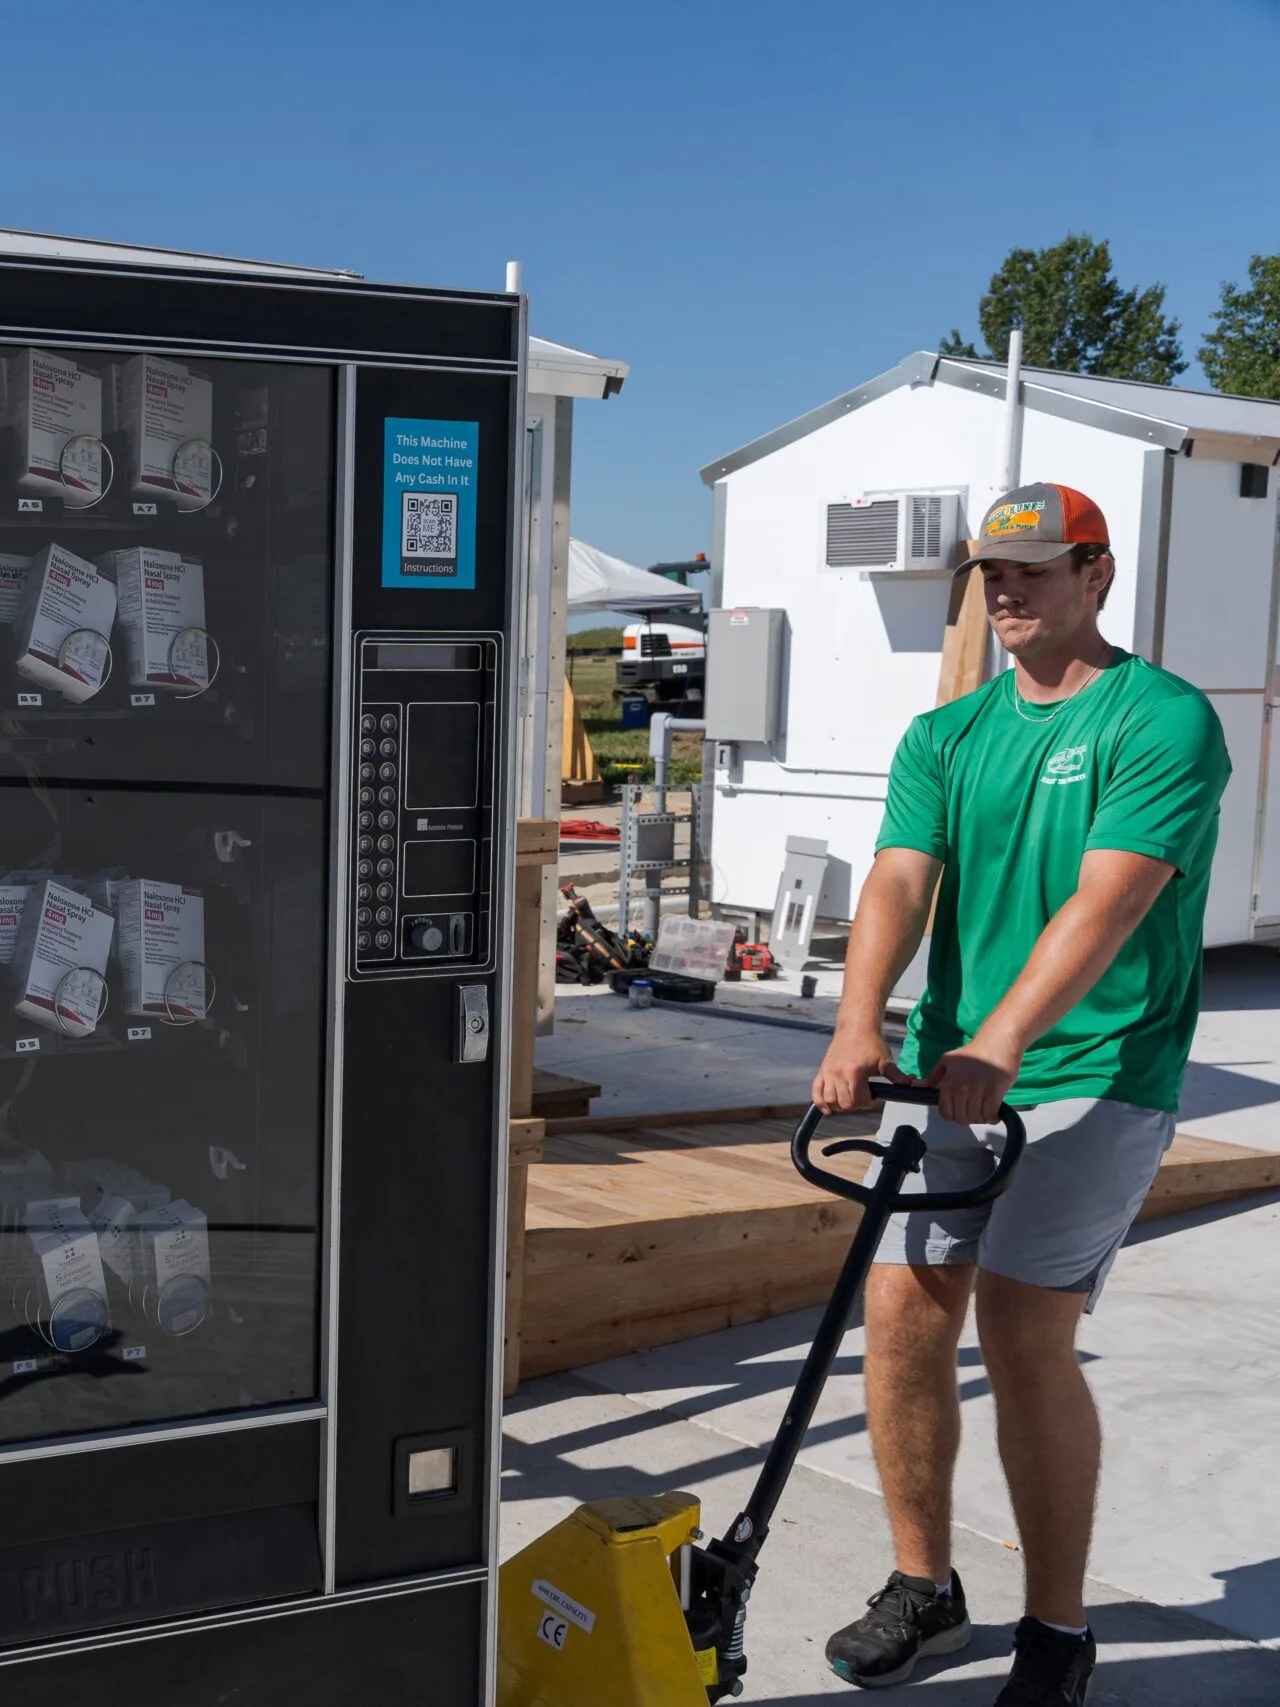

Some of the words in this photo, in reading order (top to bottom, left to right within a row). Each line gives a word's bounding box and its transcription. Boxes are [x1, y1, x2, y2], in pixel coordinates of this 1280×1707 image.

[33, 360, 66, 377] Naloxone
[33, 368, 53, 380] Nasal
[54, 375, 74, 388] Spray
[396, 435, 417, 446] This
[421, 436, 467, 448] Machine
[393, 454, 419, 465] Does
[422, 456, 442, 466] Not
[445, 457, 472, 468] Have
[396, 472, 416, 486] Any
[419, 473, 445, 485] Cash
[448, 475, 457, 485] In
[461, 476, 469, 485] It
[423, 525, 436, 533] ME
[52, 554, 85, 577] Naloxone
[86, 572, 98, 584] HCl
[144, 560, 174, 571] Naloxone
[405, 563, 453, 573] Instructions
[51, 562, 70, 579] Nasal
[71, 574, 92, 588] Spray
[144, 569, 161, 579] Nasal
[163, 572, 180, 582] Spray
[385, 743, 390, 752] 2
[361, 816, 368, 825] E
[361, 841, 367, 849] F
[382, 840, 387, 848] 6
[360, 864, 367, 873] G
[145, 892, 173, 904] Naloxone
[175, 897, 185, 905] HCl
[360, 888, 367, 897] H
[48, 892, 80, 911] Naloxone
[81, 905, 94, 918] HCl
[145, 900, 162, 910] Nasal
[163, 903, 180, 914] Spray
[47, 900, 66, 914] Nasal
[67, 908, 86, 924] Spray
[380, 912, 386, 920] 9
[359, 936, 365, 944] K
[379, 935, 387, 943] 10
[21, 1547, 156, 1623] PUSH
[543, 1616, 566, 1647] CE
